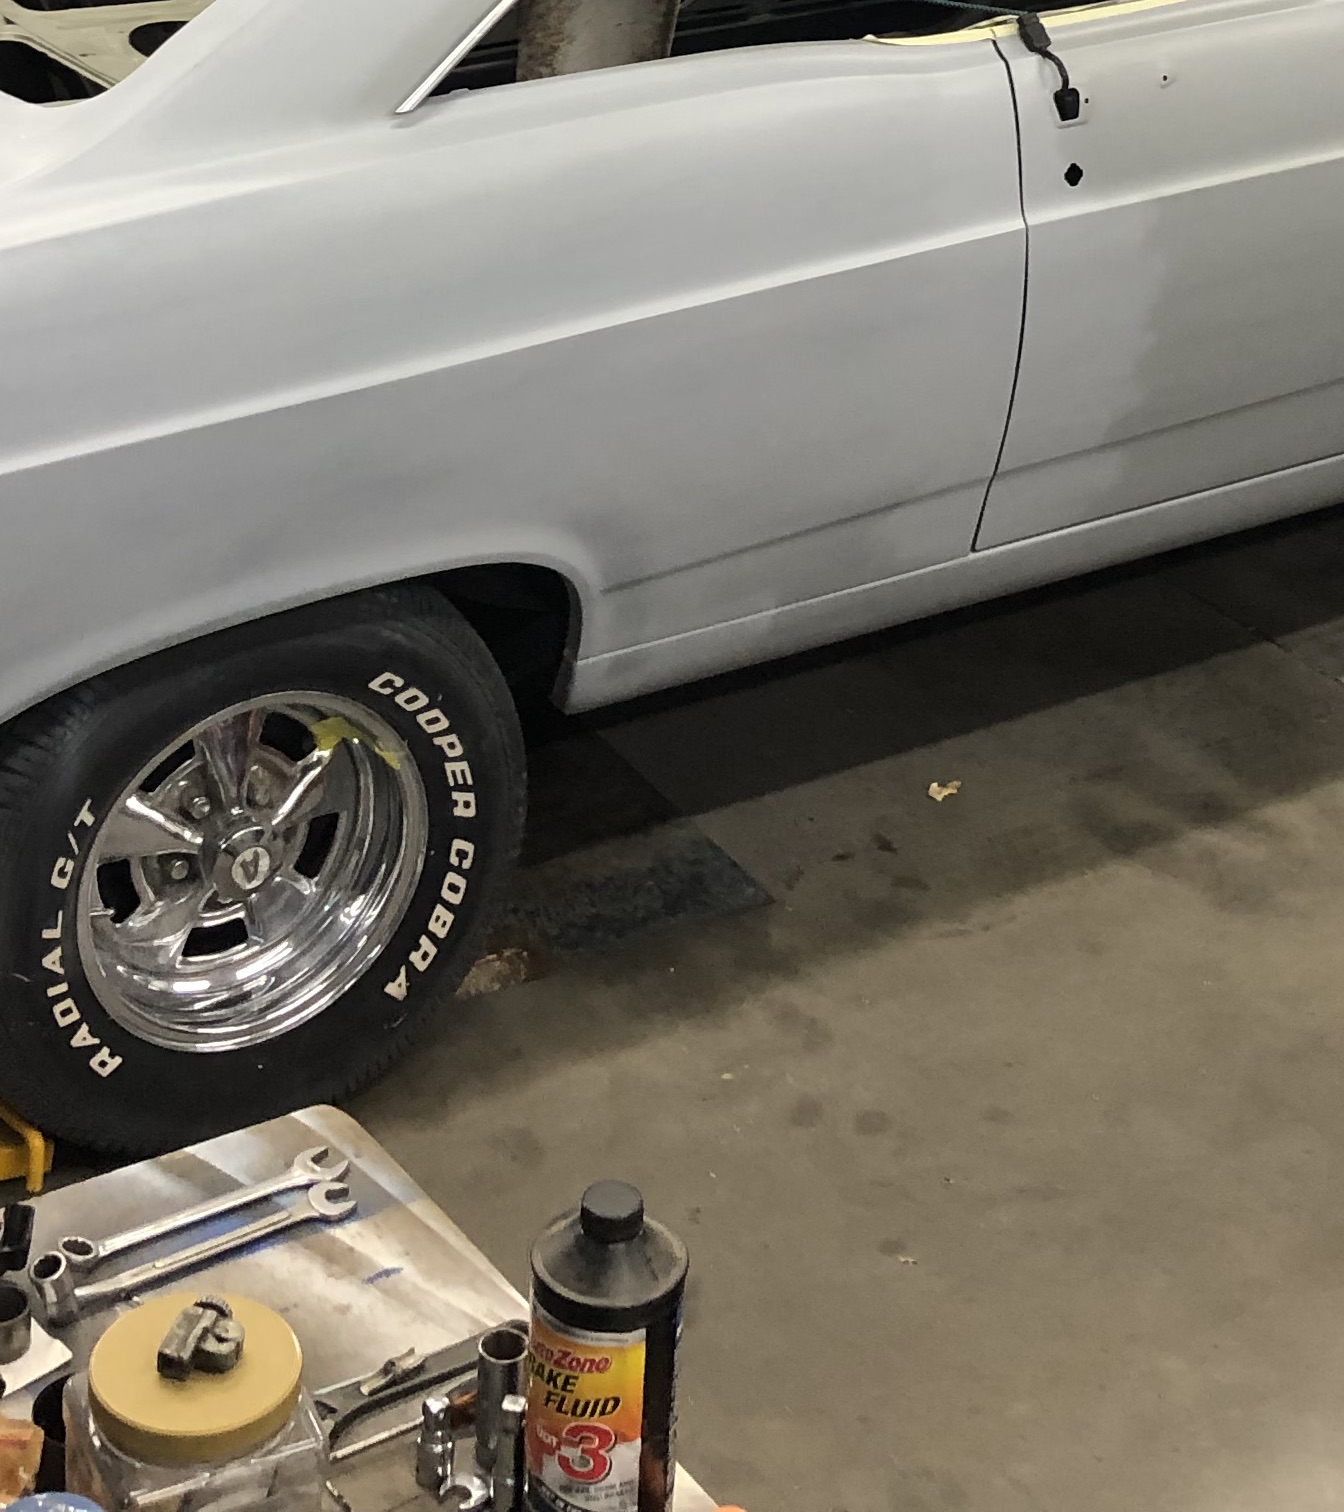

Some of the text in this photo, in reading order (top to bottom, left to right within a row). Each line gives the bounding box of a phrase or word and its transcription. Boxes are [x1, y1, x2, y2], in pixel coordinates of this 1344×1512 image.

[367, 671, 478, 1002] COOPER COBRA
[41, 797, 123, 1078] RADIAL G/T
[527, 1352, 579, 1393] RAKE
[544, 1389, 621, 1419] FLUID
[556, 1421, 617, 1485] 3
